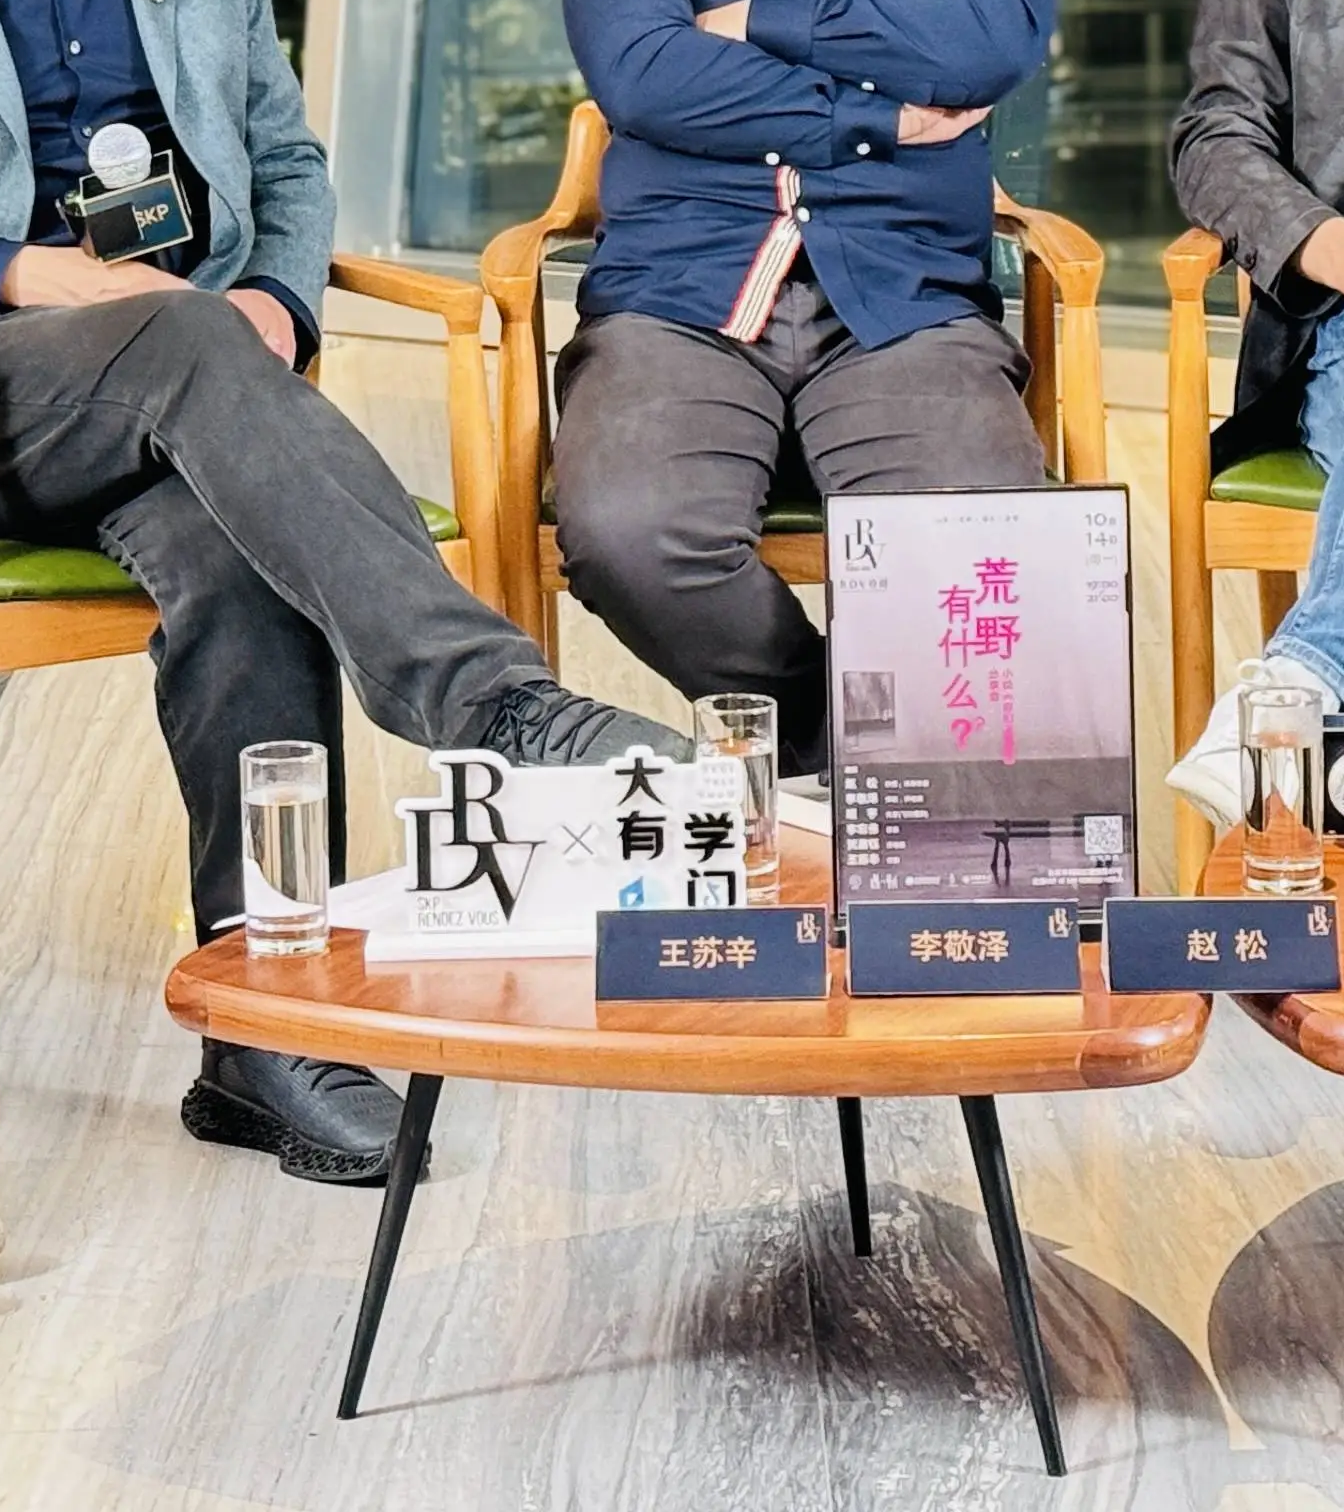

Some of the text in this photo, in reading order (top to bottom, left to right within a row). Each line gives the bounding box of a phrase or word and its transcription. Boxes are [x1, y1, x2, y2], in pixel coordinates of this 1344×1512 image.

[972, 556, 1022, 661] 荒野
[658, 935, 757, 970] 王苏辛
[909, 928, 1010, 963] 李敬泽
